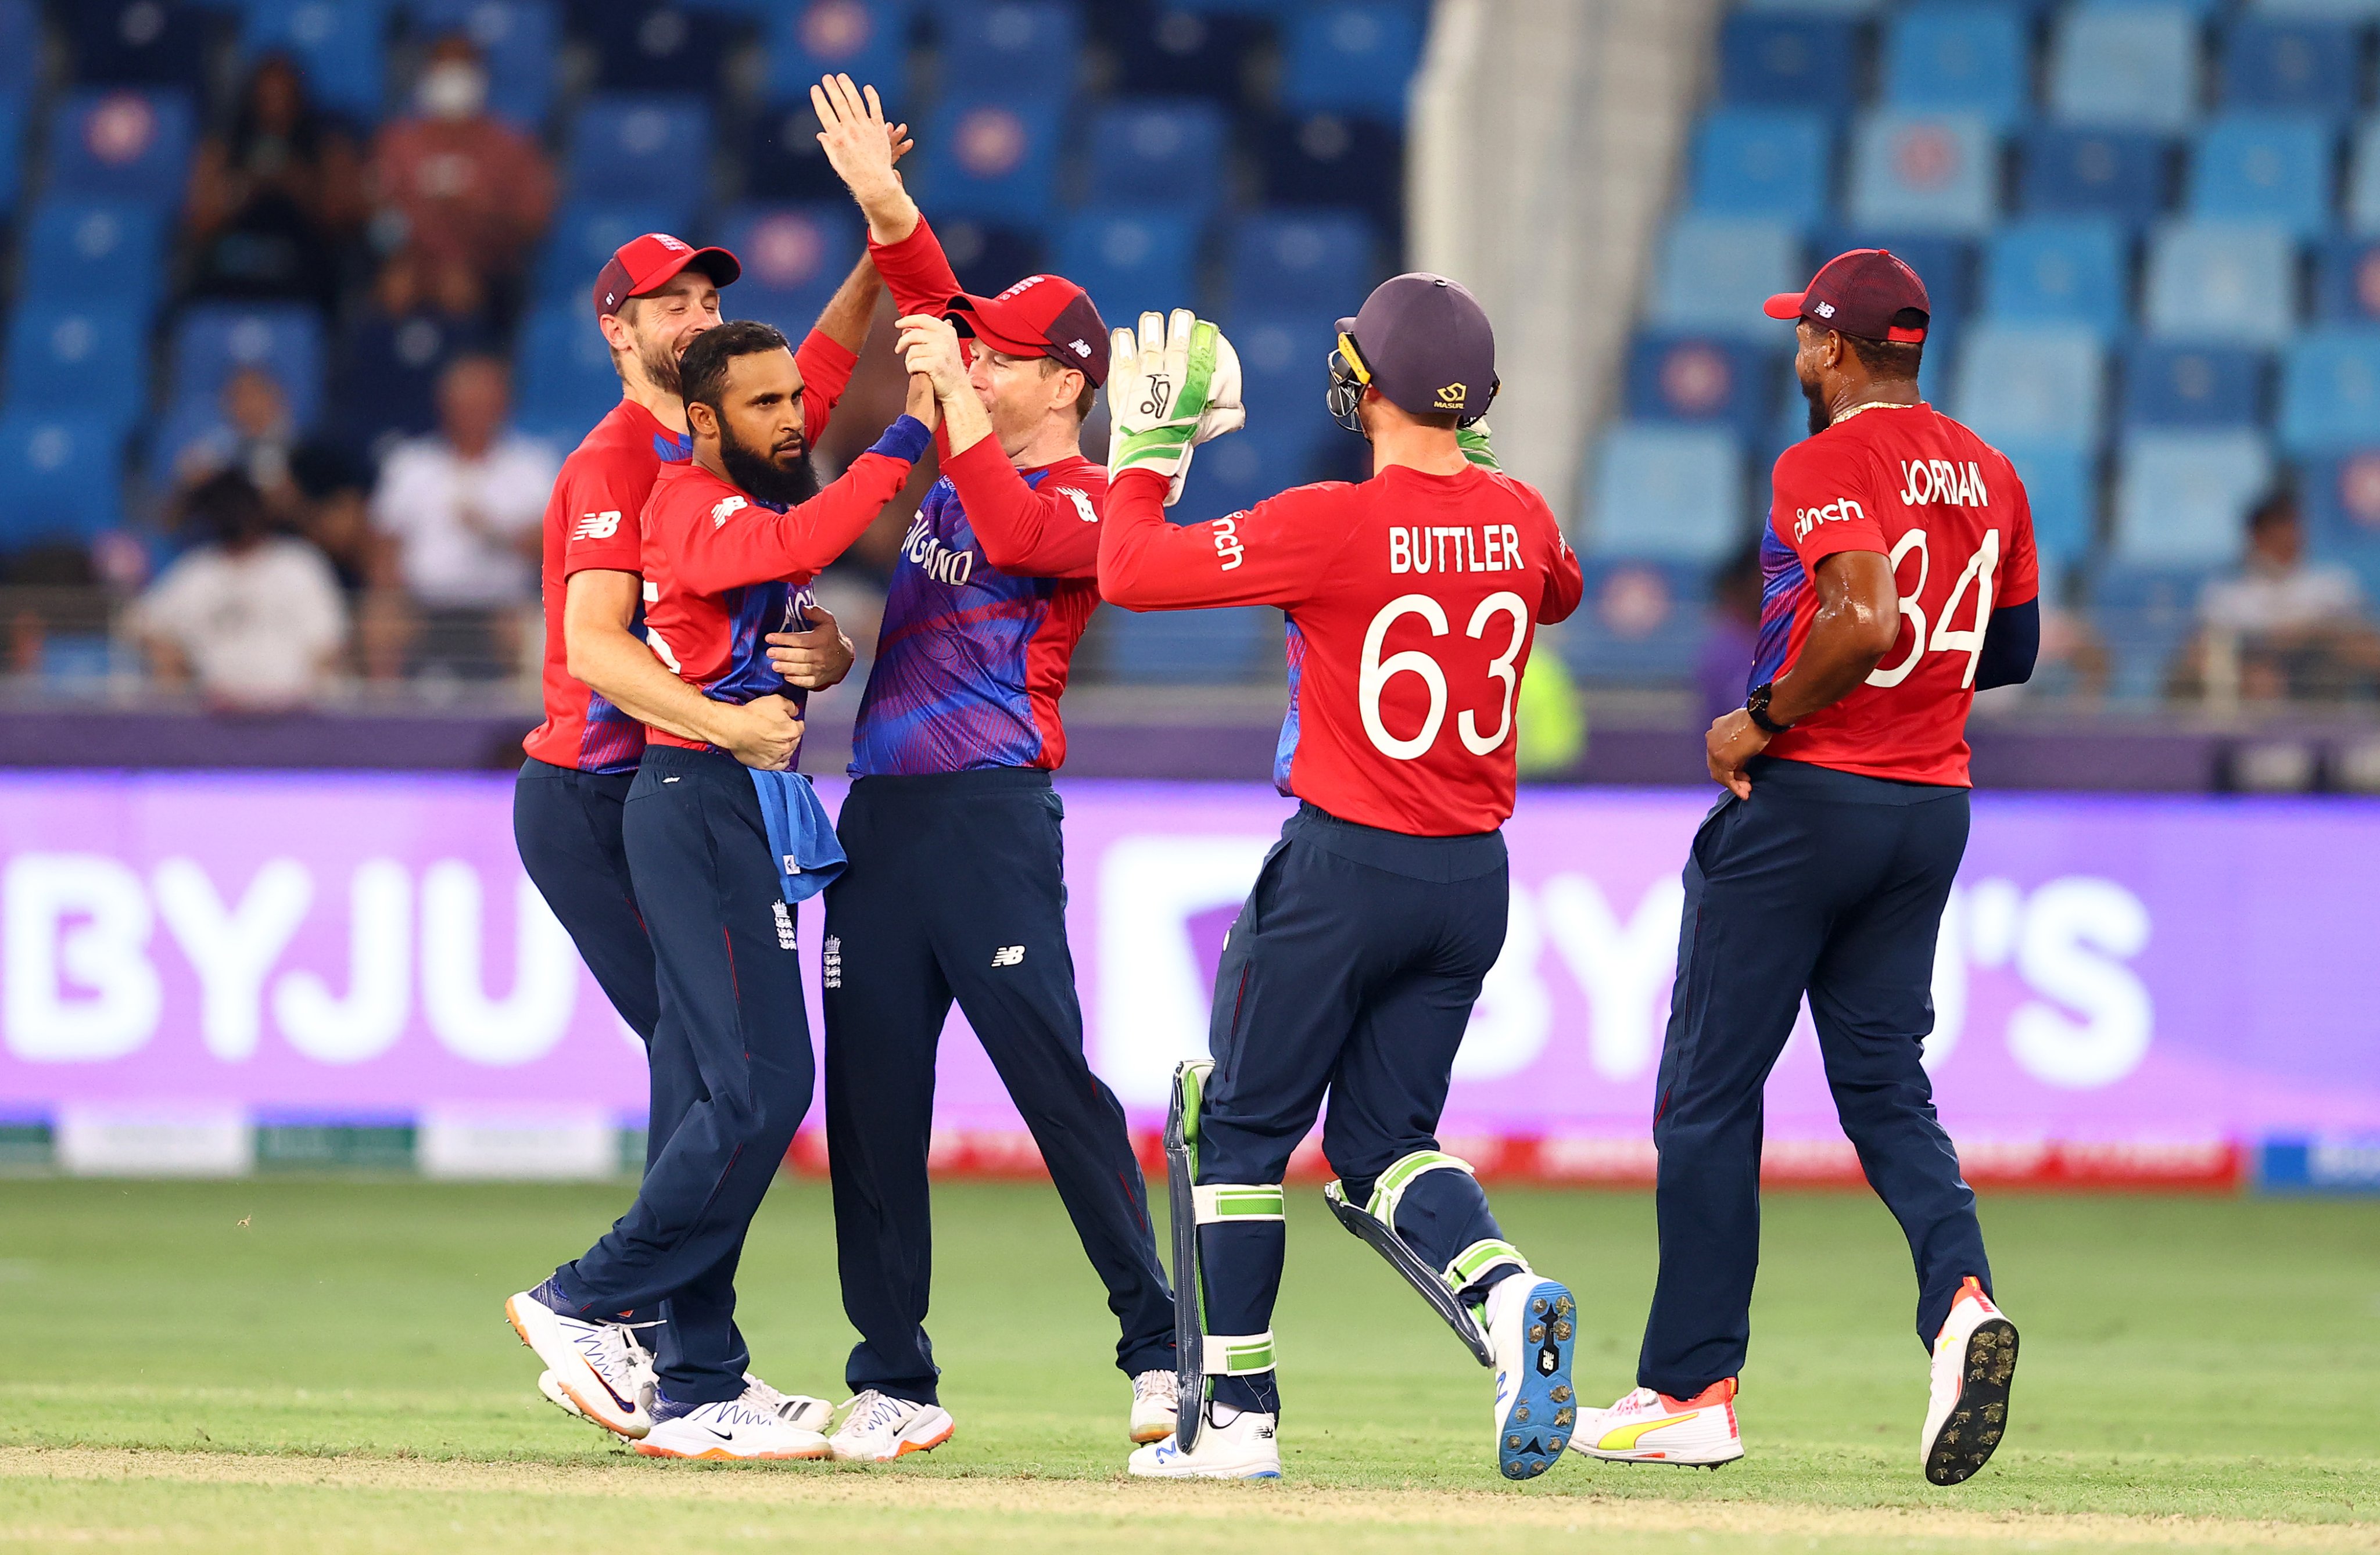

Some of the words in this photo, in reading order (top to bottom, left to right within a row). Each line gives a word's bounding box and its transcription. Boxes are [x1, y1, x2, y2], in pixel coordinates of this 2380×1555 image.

[1900, 459, 1989, 507] JORDAN
[1211, 511, 1245, 571] inch
[1389, 524, 1525, 574] BUTTLER
[1794, 498, 1865, 544] cinch
[1865, 529, 1999, 689] 34
[1359, 591, 1528, 760] 63
[5, 854, 581, 1066] BYJU
